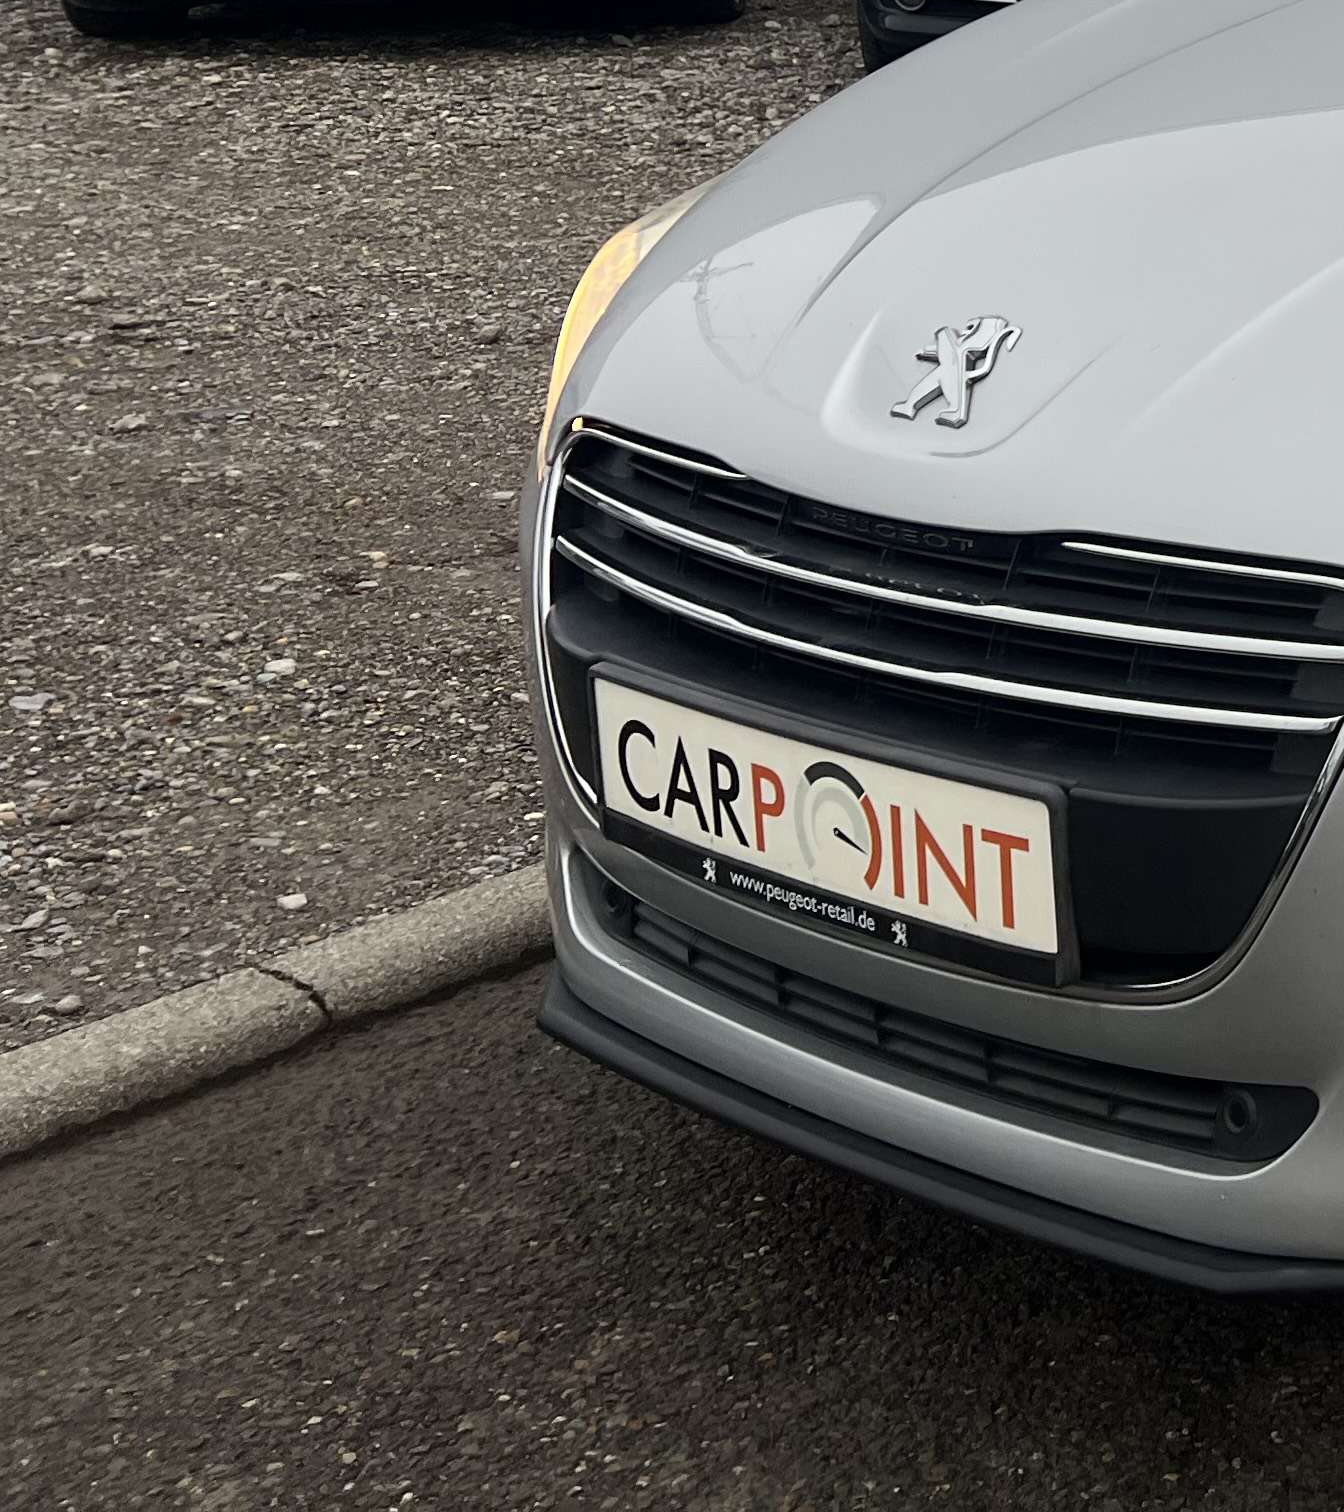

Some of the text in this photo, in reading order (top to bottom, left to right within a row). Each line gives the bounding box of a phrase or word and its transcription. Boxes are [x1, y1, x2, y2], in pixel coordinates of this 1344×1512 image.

[810, 505, 976, 552] PEUGEOT
[618, 719, 1030, 930] CARPOINT
[729, 871, 876, 931] www.peugeot-retail.de
